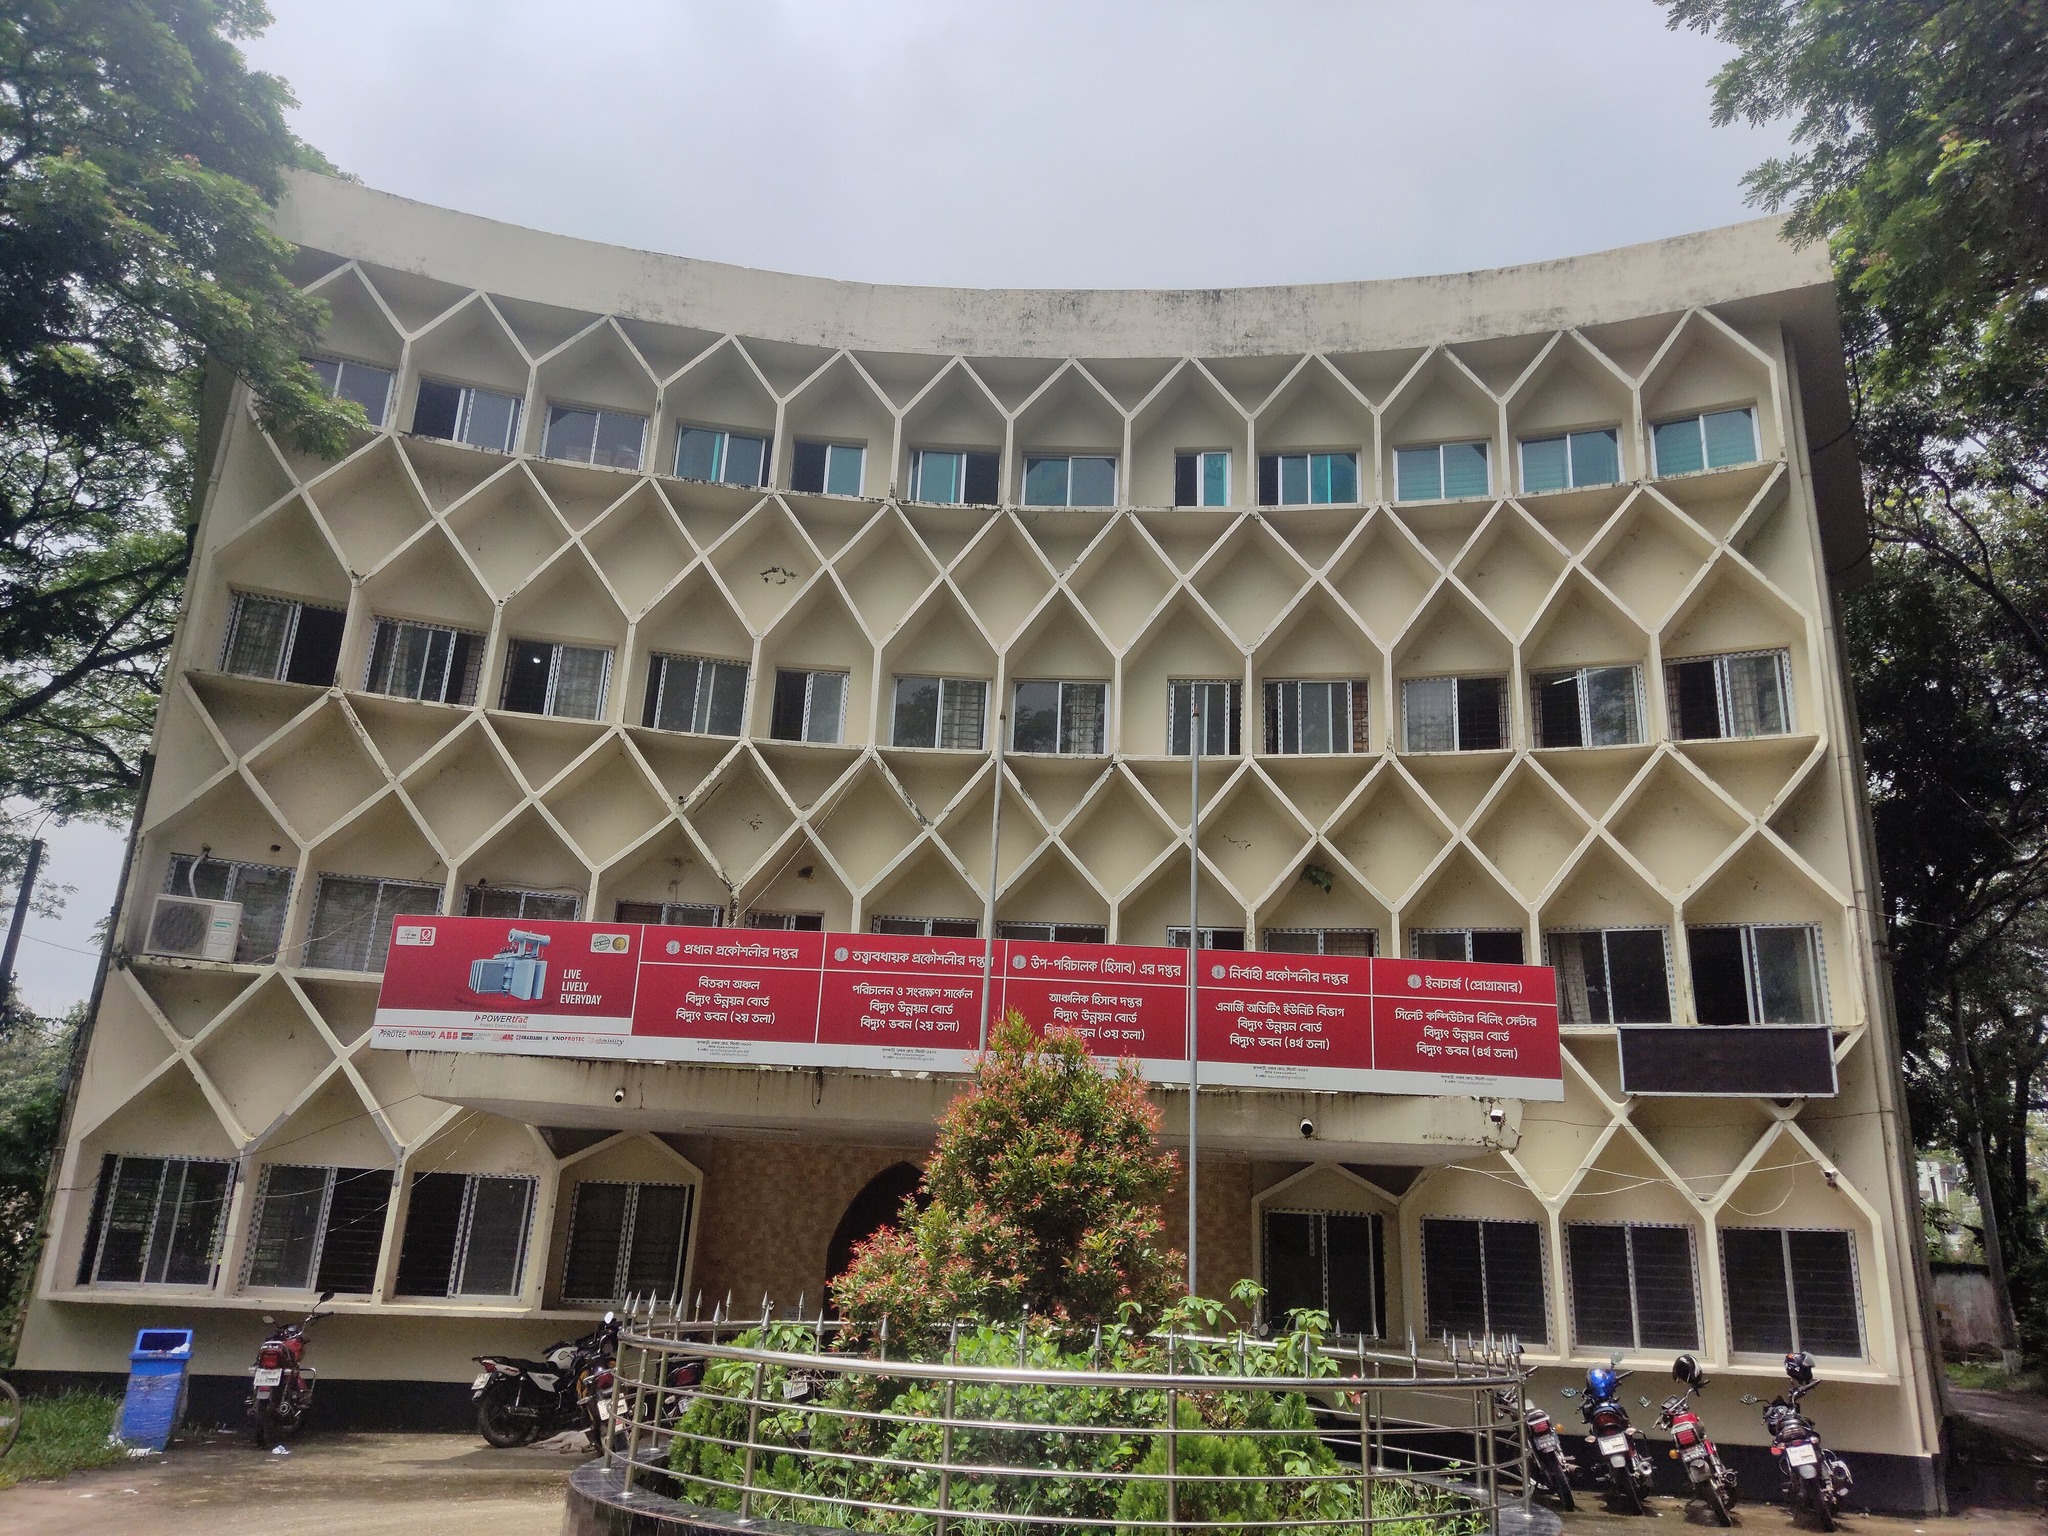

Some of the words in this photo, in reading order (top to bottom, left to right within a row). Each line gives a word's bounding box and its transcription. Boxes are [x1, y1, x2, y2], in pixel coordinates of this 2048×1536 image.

[684, 944, 712, 955] প্রধান
[716, 941, 769, 958] প্রকৌশলীর
[773, 948, 798, 960] দপ্তর
[912, 949, 965, 966] প্রকৌশলীর
[969, 956, 994, 968] দপ্ত
[563, 969, 581, 980] LIVE
[1100, 959, 1136, 975] (হিসাব)
[1140, 964, 1154, 975] এর
[1158, 965, 1181, 977] দপ্তর
[1229, 965, 1262, 980] নির্বাহী
[1265, 966, 1319, 983] প্রকৌশলীর
[1323, 973, 1348, 986] দপ্তর
[561, 981, 589, 992] LIVELY
[699, 976, 730, 988] বিতরণ
[733, 980, 760, 990] অঞ্চল
[852, 982, 893, 995] পরিচালন
[896, 987, 903, 996] ও
[906, 988, 940, 998] সংরক্ষণ
[944, 987, 973, 999] সার্কেল
[1425, 976, 1461, 989] ইনচার্জ
[1465, 977, 1522, 993] (প্রোগ্রামার)
[560, 993, 602, 1005] EVERYDAY
[686, 992, 710, 1007] বিদ্যুৎ
[714, 993, 744, 1008] উন্নয়ন
[747, 995, 769, 1007] বোর্ড
[1049, 991, 1089, 1004] আঞ্চলিক
[1092, 993, 1117, 1006] হিসাব
[1120, 997, 1142, 1008] দপ্তর
[676, 1008, 701, 1023] বিদ্যুৎ
[704, 1011, 727, 1021] ভবন
[752, 1012, 775, 1024] তলা)
[870, 1000, 894, 1015] বিদ্যুৎ
[898, 1001, 928, 1016] উন্নয়ন
[931, 1003, 953, 1014] বোর্ড
[1054, 1007, 1078, 1022] বিদ্যুৎ
[1081, 1009, 1111, 1025] উন্নয়ন
[1115, 1011, 1137, 1022] বোর্ড
[1216, 1000, 1244, 1013] এনার্জি
[1247, 1001, 1280, 1015] অডিটিং
[1283, 1002, 1314, 1015] ইউনিট
[1316, 1004, 1344, 1017] বিভাগ
[860, 1016, 885, 1031] বিদ্যুৎ
[889, 1019, 912, 1029] ভবন
[936, 1020, 960, 1032] তলা)
[1238, 1017, 1262, 1032] বিদ্যুৎ
[1266, 1019, 1296, 1034] উন্নয়ন
[1300, 1021, 1322, 1032] বোর্ড
[1395, 1008, 1422, 1020] সিলেট
[1477, 1012, 1503, 1025] বিলিং
[1506, 1016, 1537, 1027] সেন্টার
[438, 1032, 458, 1040] ABB
[1122, 1029, 1145, 1041] তলা)
[1230, 1033, 1255, 1048] বিদ্যুৎ
[1258, 1036, 1282, 1047] ভবন
[1306, 1038, 1330, 1050] তলা)
[1424, 1026, 1449, 1041] বিদ্যুৎ
[1452, 1028, 1483, 1043] উন্নয়ন
[1487, 1030, 1509, 1042] বোর্ড
[1417, 1042, 1442, 1057] বিদ্যুৎ
[1445, 1045, 1469, 1056] ভবন
[1494, 1047, 1518, 1059] তলা)
